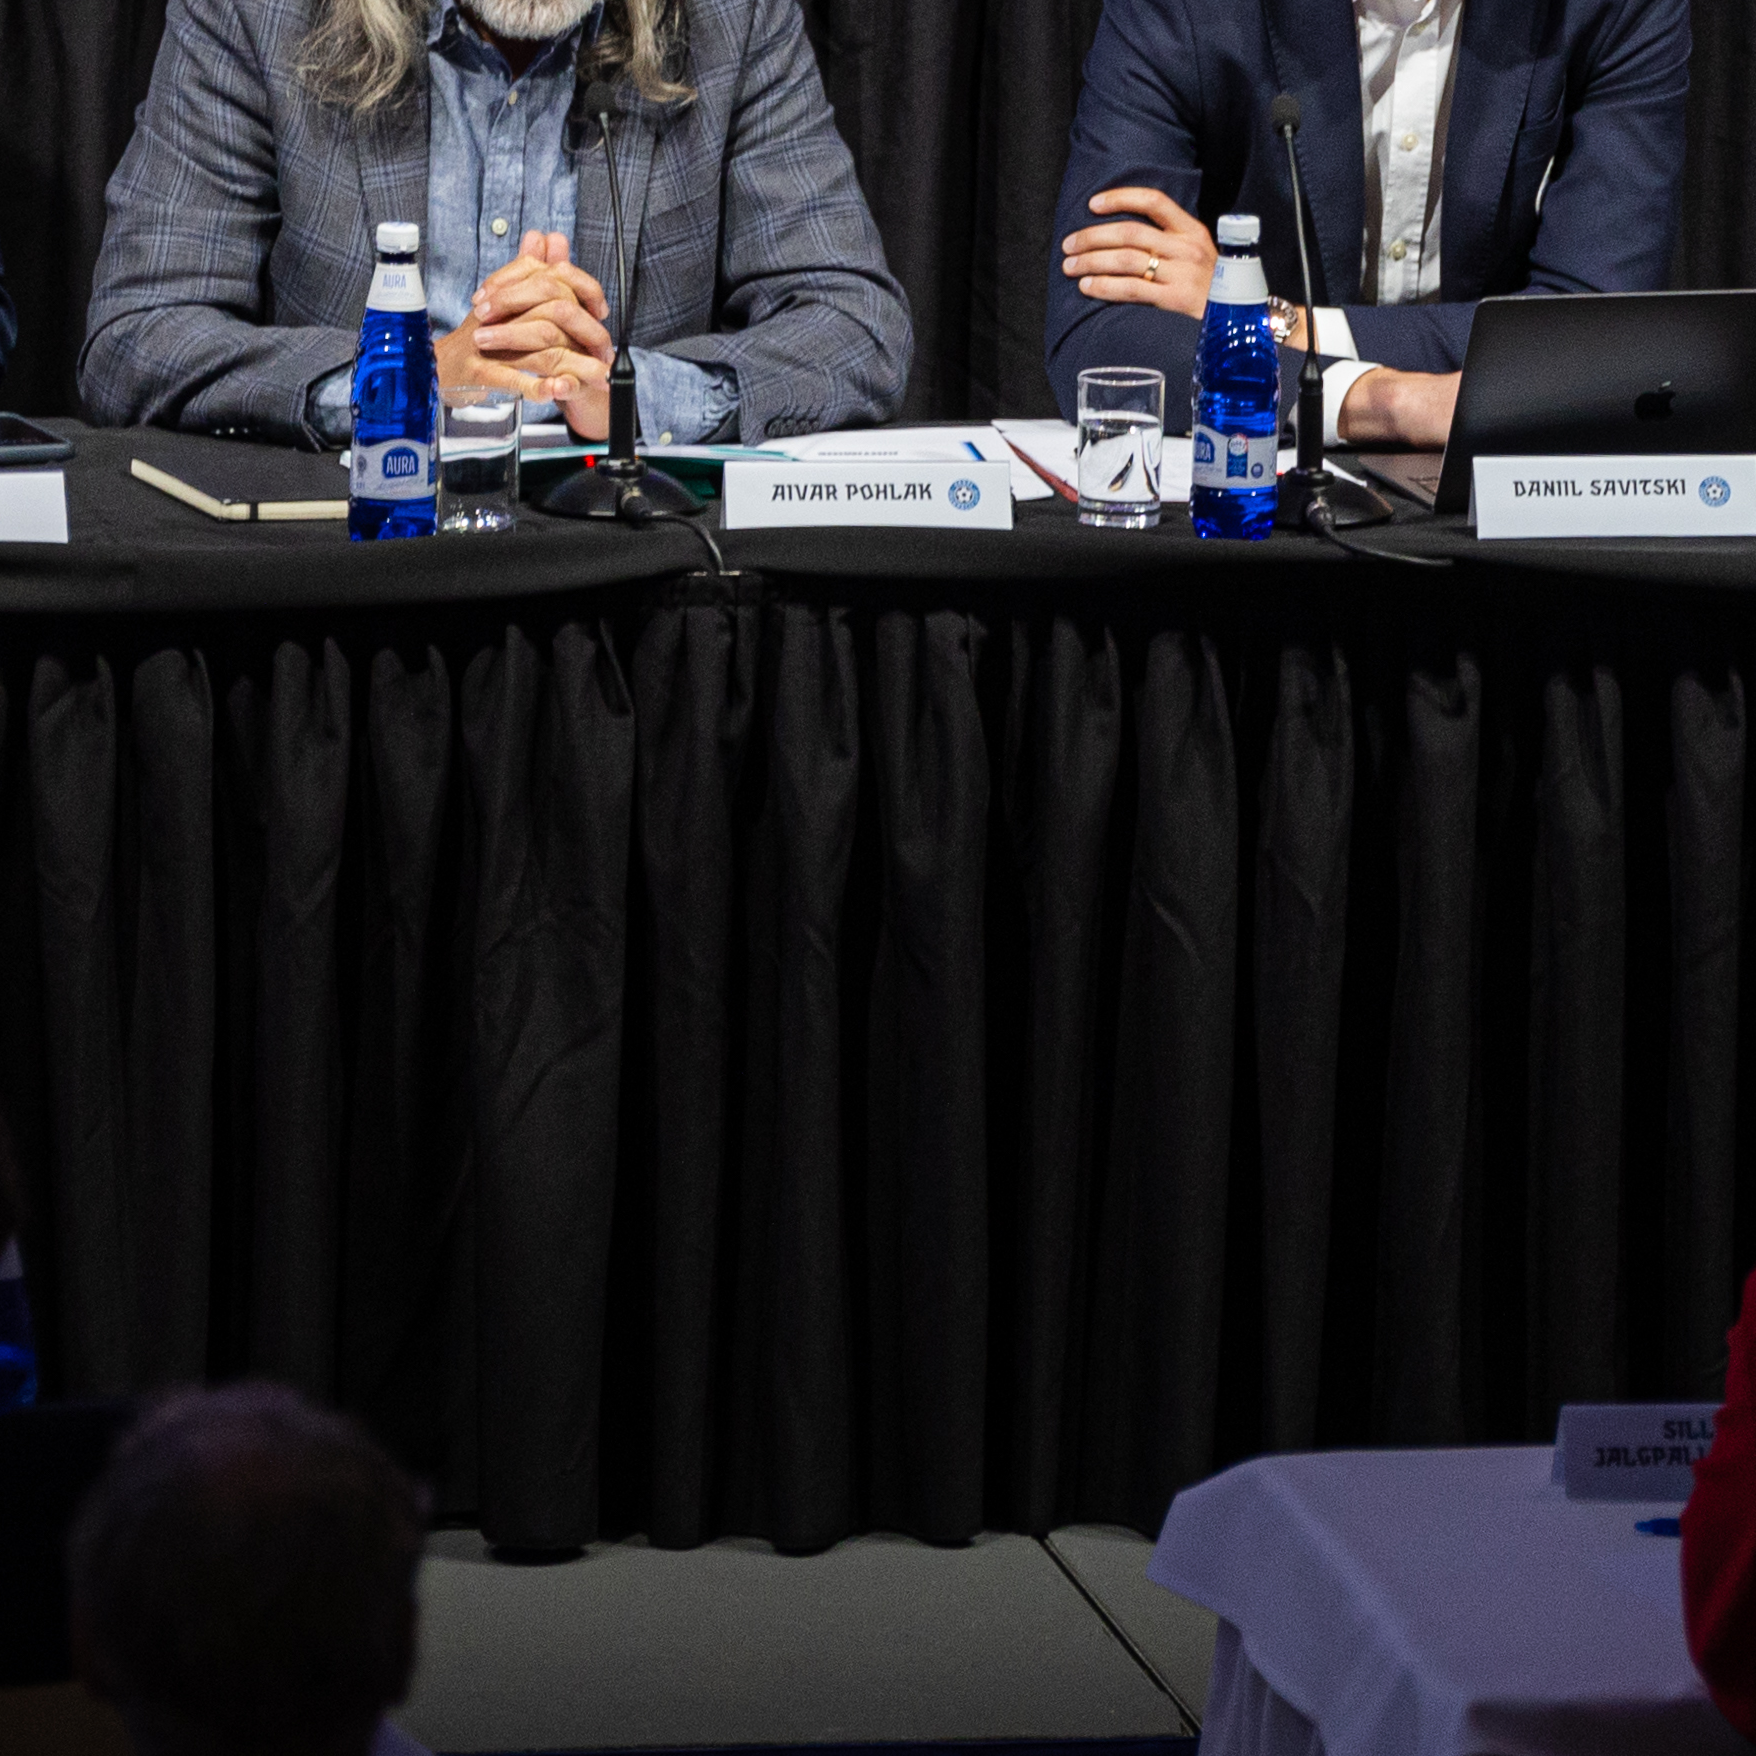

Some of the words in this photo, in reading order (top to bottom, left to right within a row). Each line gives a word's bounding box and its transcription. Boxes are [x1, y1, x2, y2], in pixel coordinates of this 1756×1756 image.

[383, 274, 406, 288] AURA
[386, 456, 415, 474] AURA
[772, 483, 838, 502] AIVAR
[847, 482, 932, 501] POHLAK
[1513, 479, 1582, 497] DANIIL
[1590, 478, 1686, 496] SAVITSKI
